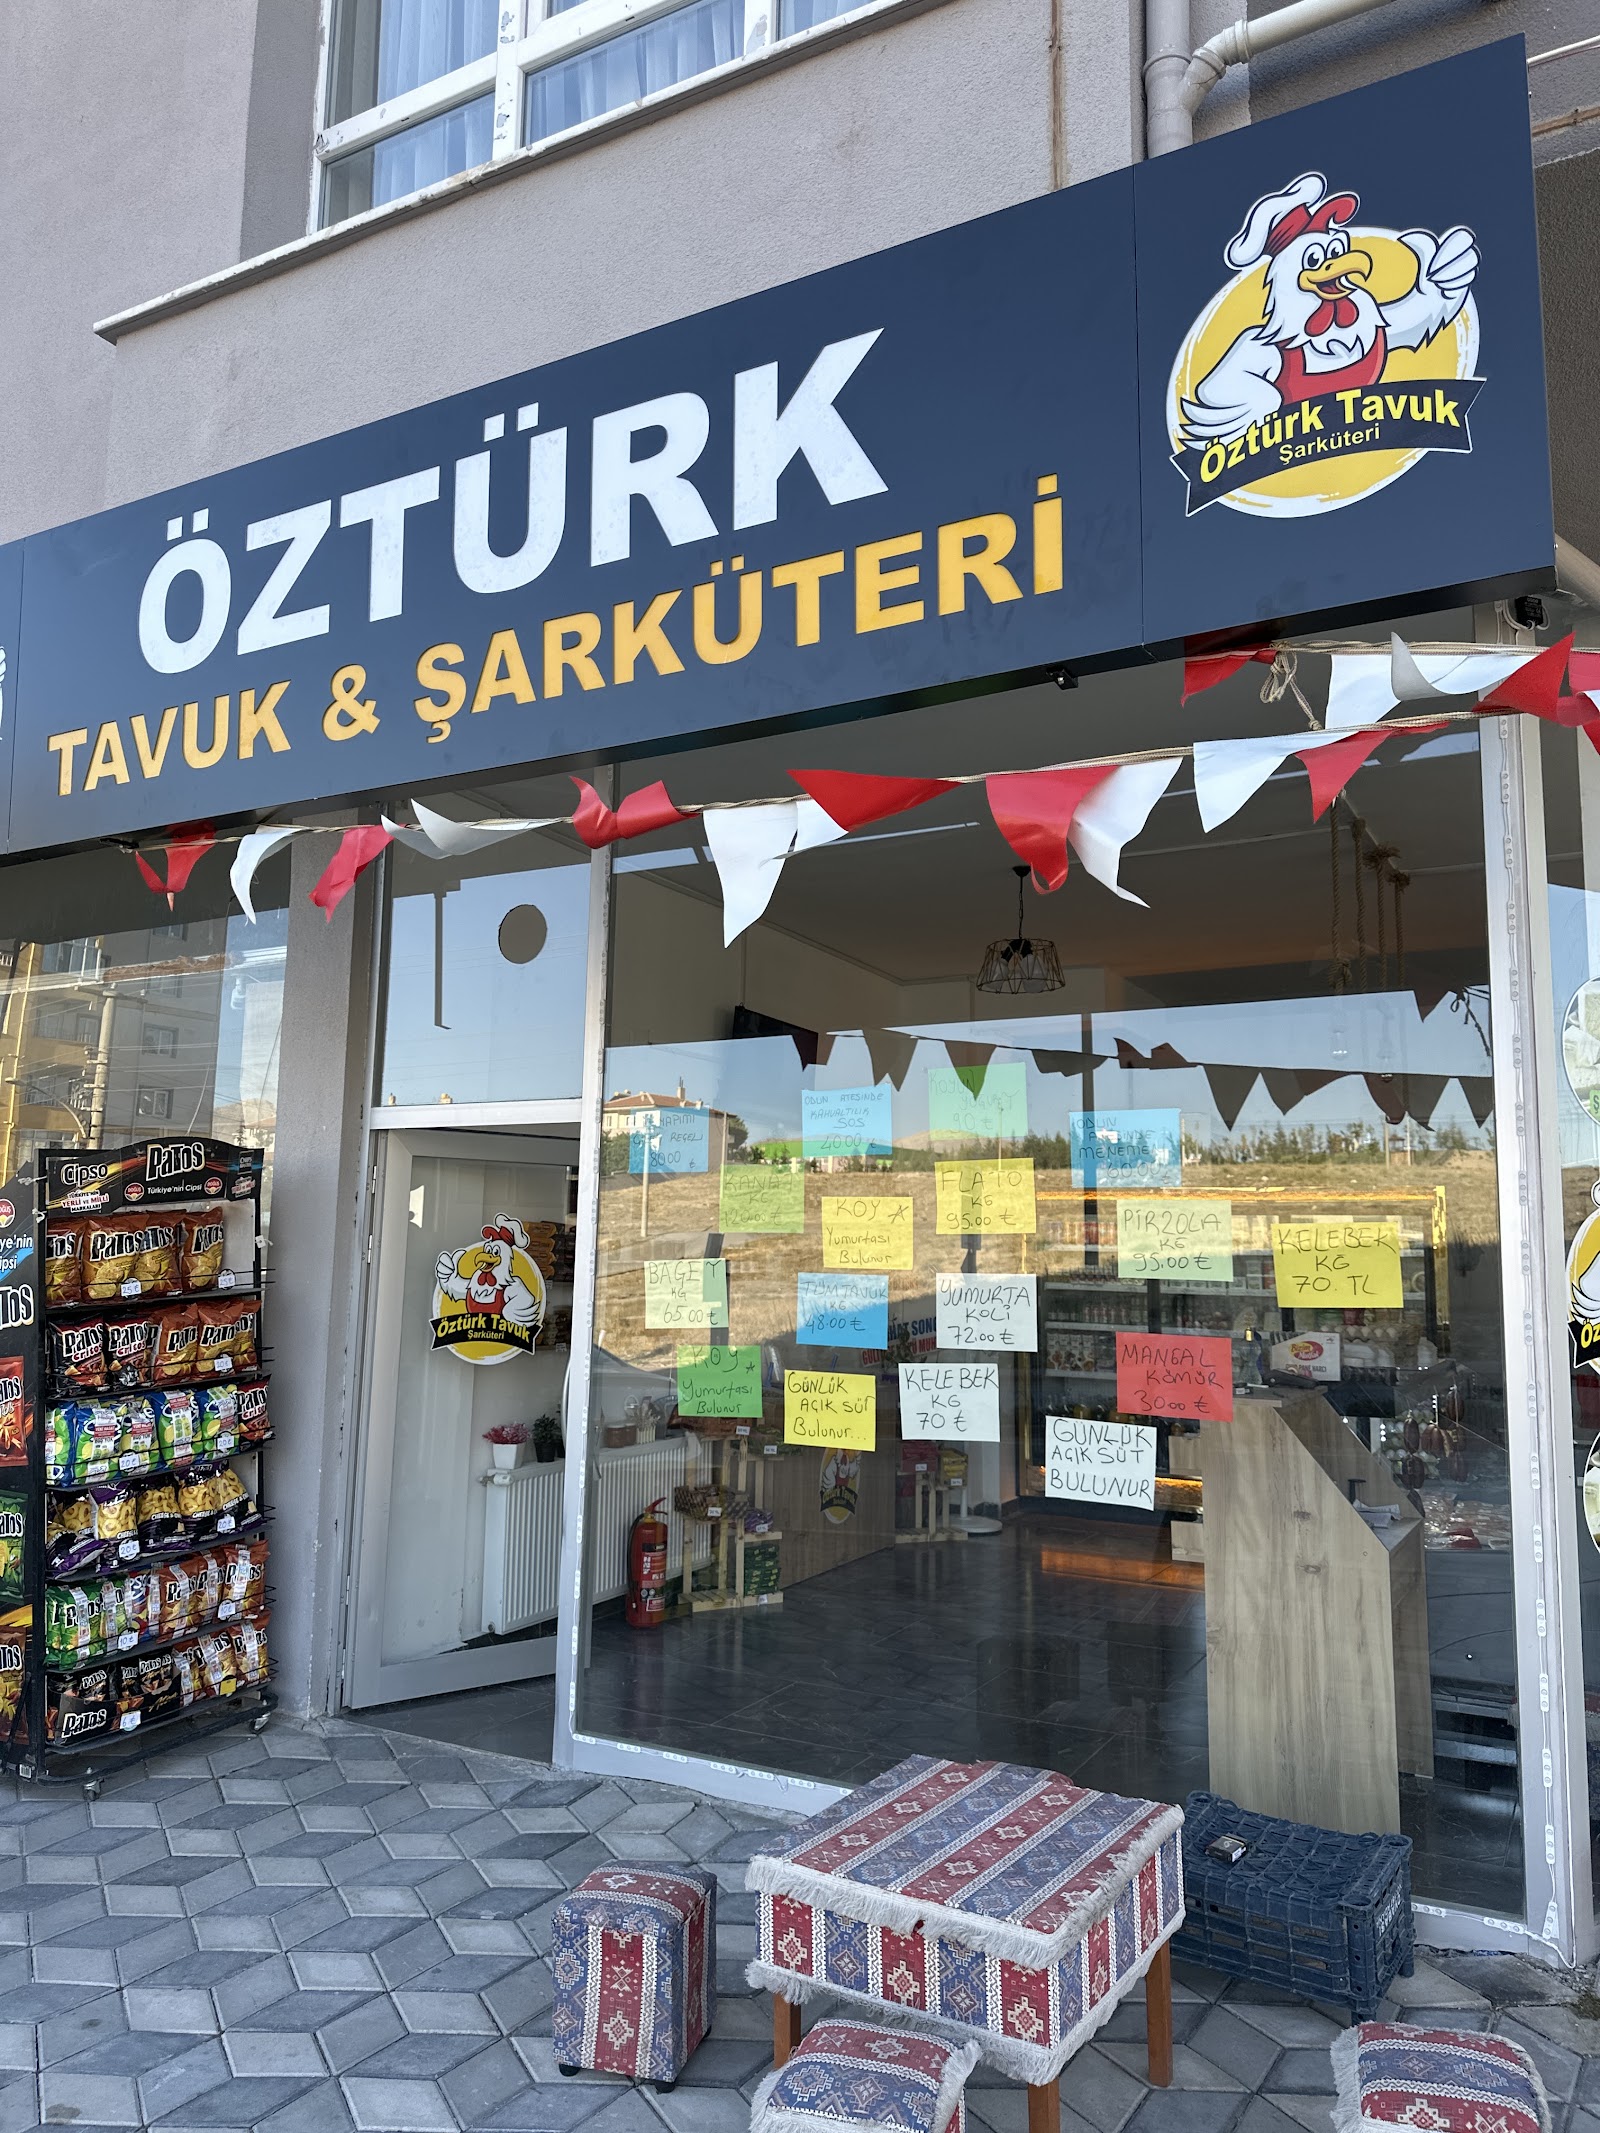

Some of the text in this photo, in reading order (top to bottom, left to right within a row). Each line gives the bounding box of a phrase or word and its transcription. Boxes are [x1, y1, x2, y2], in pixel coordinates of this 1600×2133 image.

[1200, 388, 1461, 484] Öztürk Tavuk
[1279, 423, 1381, 466] Şarküteri
[137, 327, 889, 674] ÖZTÜRK
[47, 473, 1063, 796] TAVUK & ŞARKÜTERİ
[804, 1096, 828, 1105] ODUN
[833, 1118, 865, 1128] SOS
[185, 1184, 202, 1192] Cipsi
[749, 1192, 769, 1205] KG
[971, 1194, 993, 1209] KG
[827, 1226, 890, 1246] Yumurtası
[1278, 1227, 1396, 1254] KELEBEK
[839, 1249, 892, 1265] Bulunur
[1133, 1252, 1189, 1271] 95.00
[1315, 1254, 1350, 1271] KG
[842, 1284, 888, 1299] TAVUK
[940, 1279, 1030, 1306] YUMURTA
[1348, 1275, 1377, 1295] TL
[437, 1313, 531, 1343] Öztürk Tavuk
[467, 1330, 504, 1340] Şarküteri
[1121, 1344, 1215, 1368] MANGAL
[788, 1372, 848, 1394] GÜNLÜK
[905, 1368, 999, 1392] KELEBEK
[683, 1378, 753, 1402] Yumurtası
[697, 1399, 742, 1414] Bulunur
[800, 1397, 837, 1413] AÇIK
[931, 1394, 961, 1408] KG
[916, 1413, 945, 1430] 70
[1053, 1419, 1152, 1448] GÜNLÜK
[1052, 1445, 1144, 1464] AÇIK SÜT
[1051, 1468, 1152, 1504] BULUNUR
